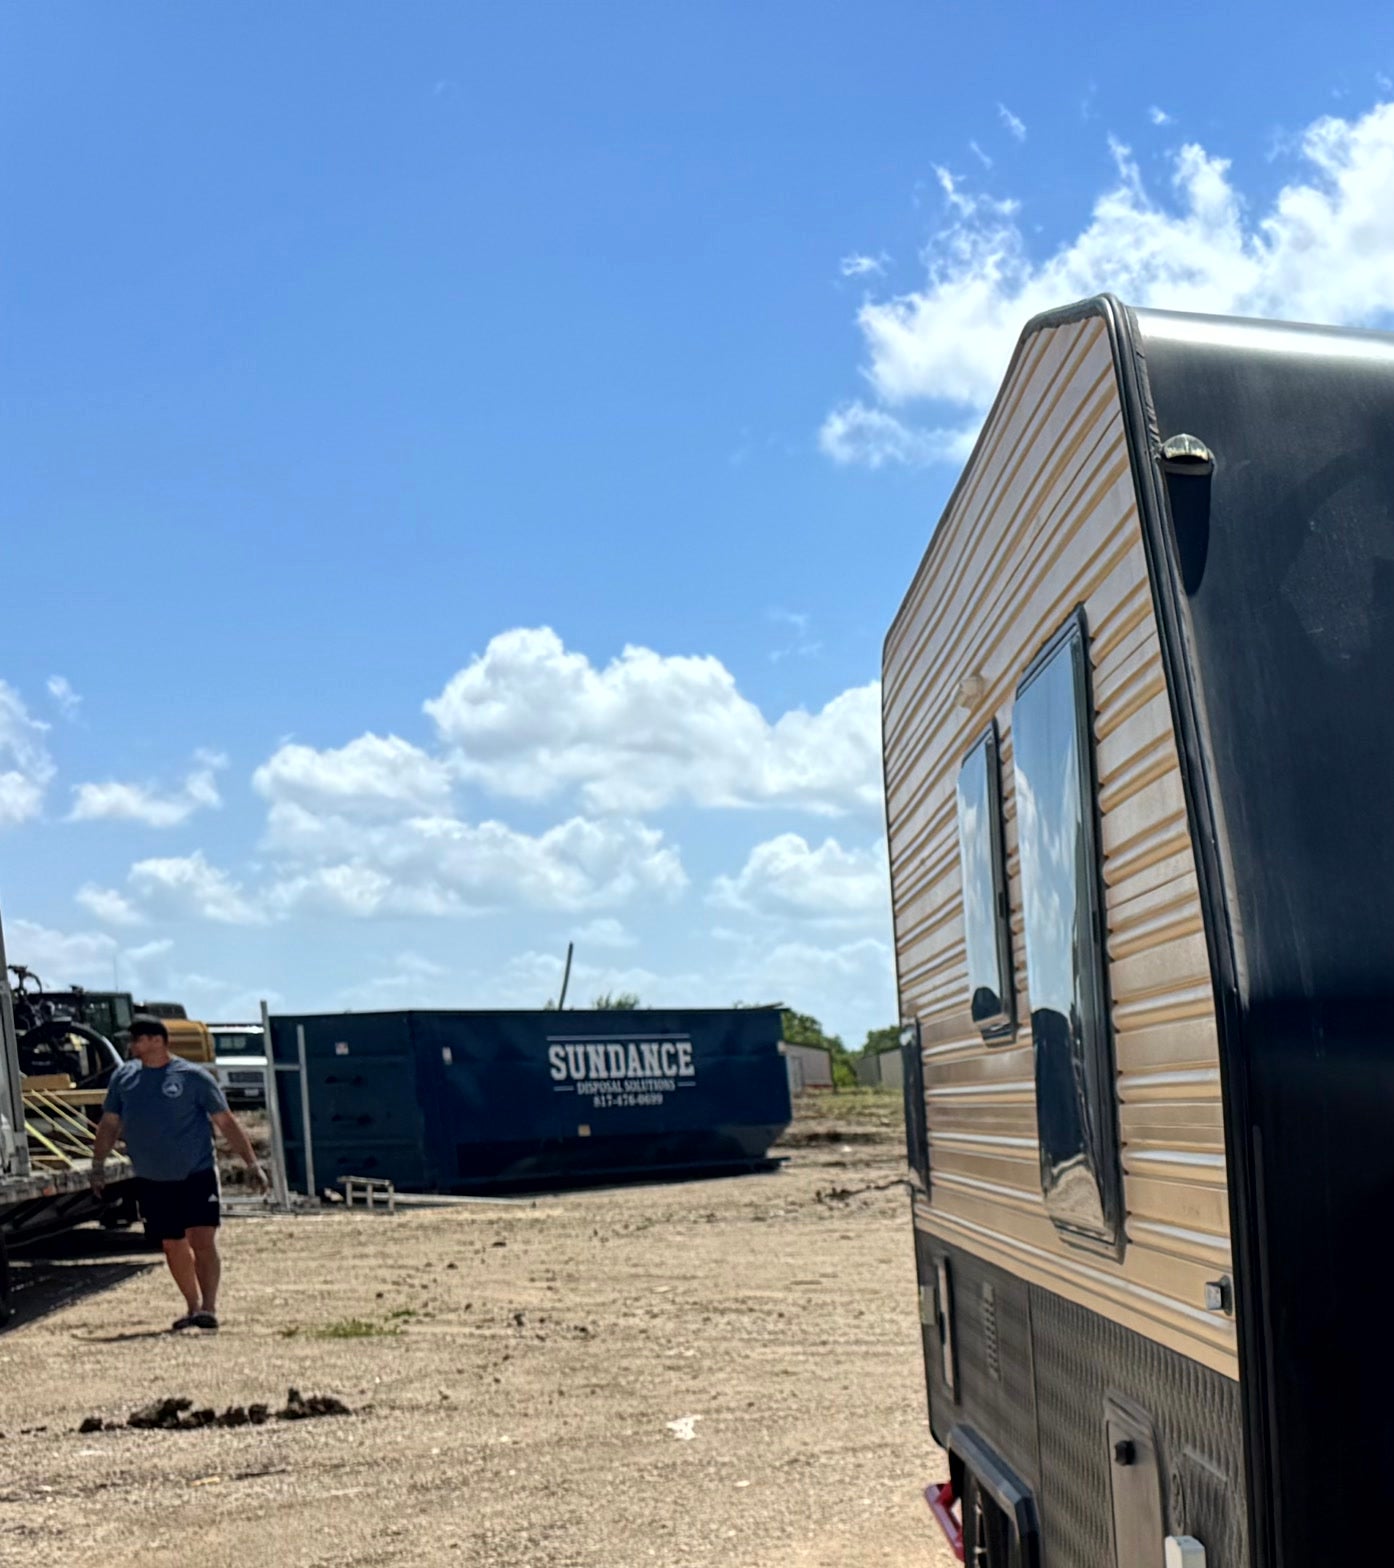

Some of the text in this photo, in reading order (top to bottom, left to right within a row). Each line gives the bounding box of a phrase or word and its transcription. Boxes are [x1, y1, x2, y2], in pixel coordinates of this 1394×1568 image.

[548, 1042, 695, 1080] SUNDANCE
[577, 1078, 676, 1095] DISPOSAL SOLUTIONS
